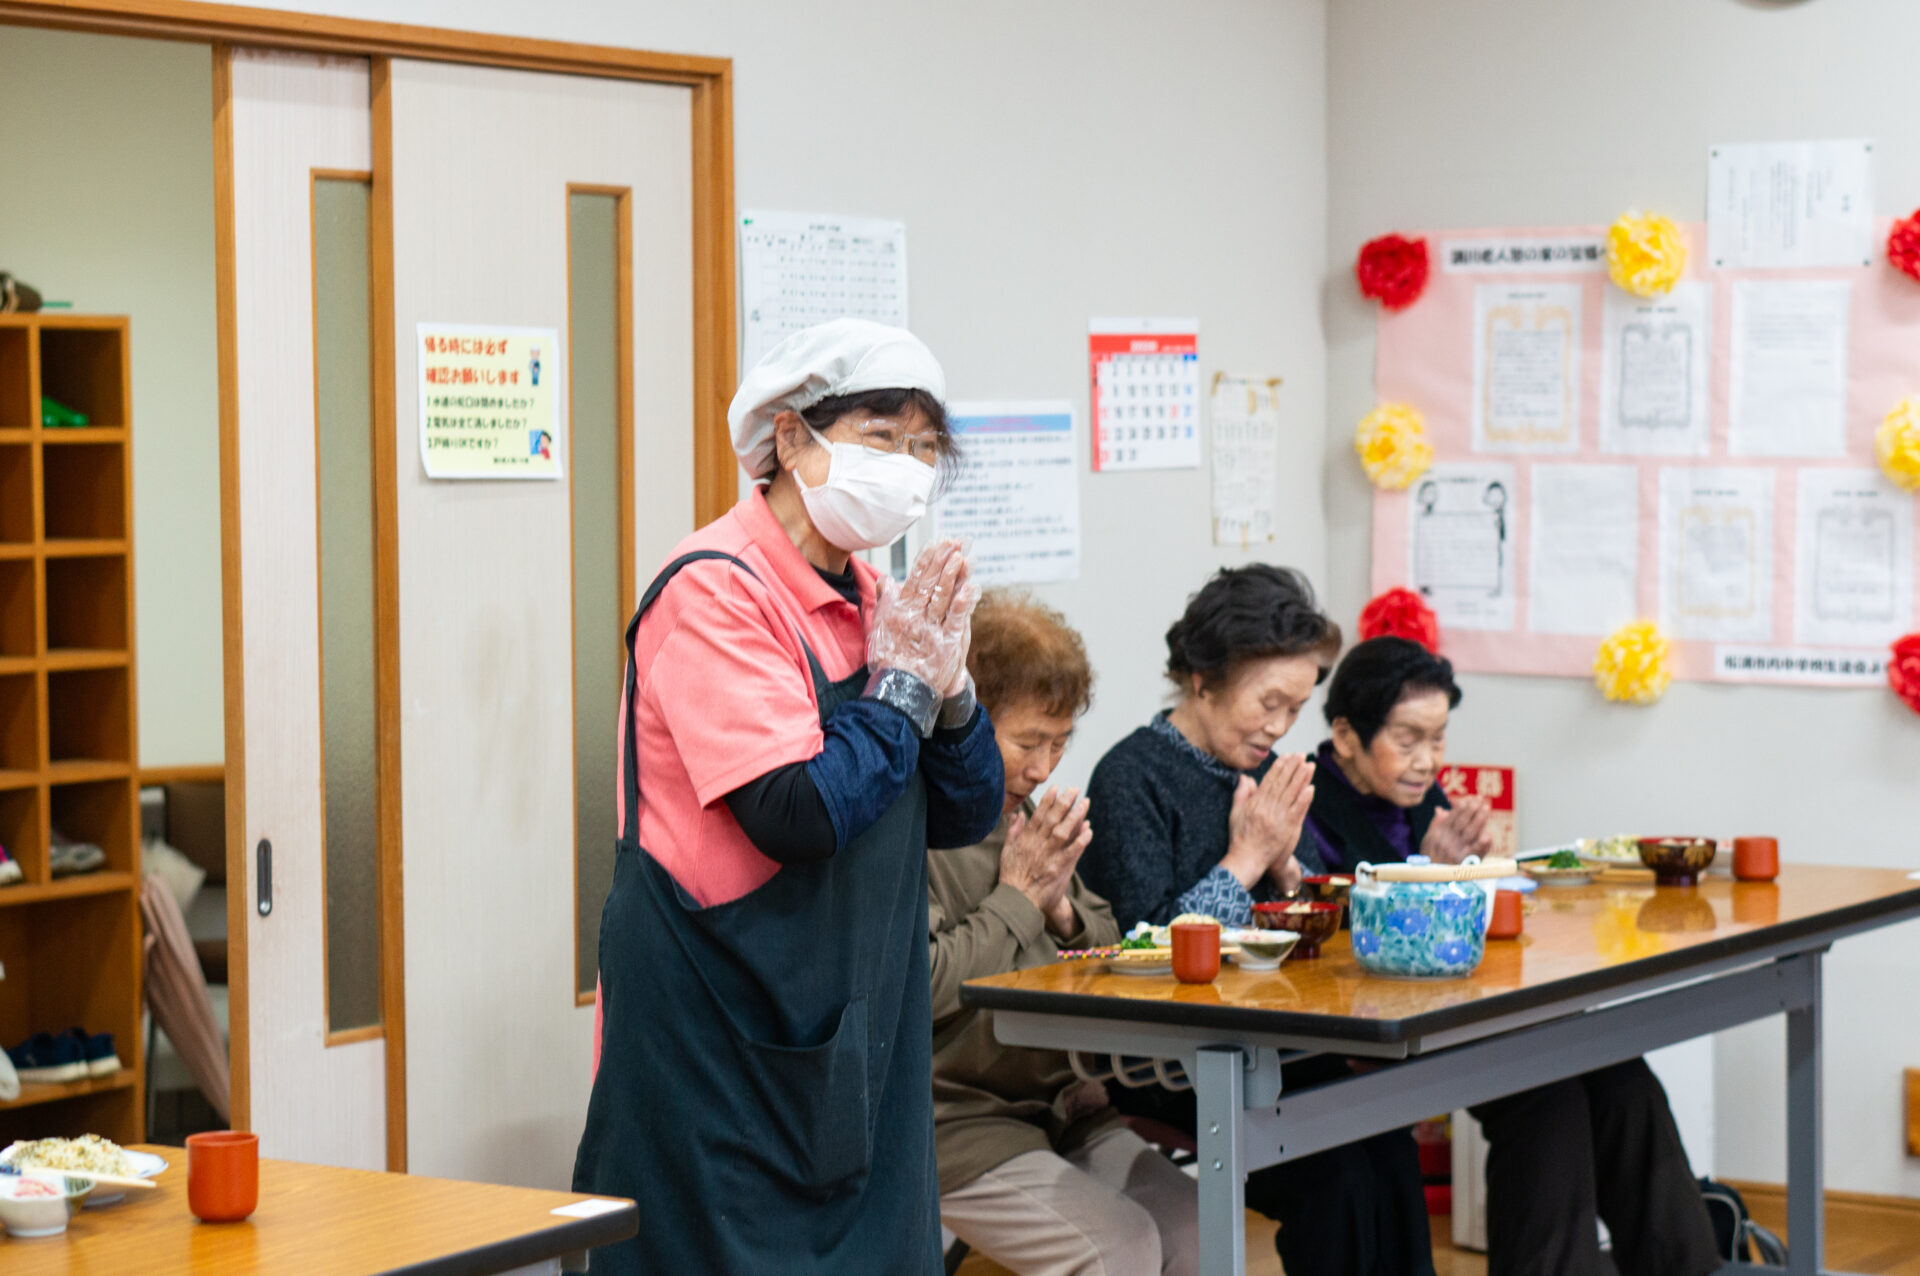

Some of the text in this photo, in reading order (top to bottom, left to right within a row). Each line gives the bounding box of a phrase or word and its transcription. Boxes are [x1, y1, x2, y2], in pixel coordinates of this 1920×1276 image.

[426, 366, 520, 386] 確認お願いします
[1725, 655, 1889, 674] 松浦市内中学校生徒会よ
